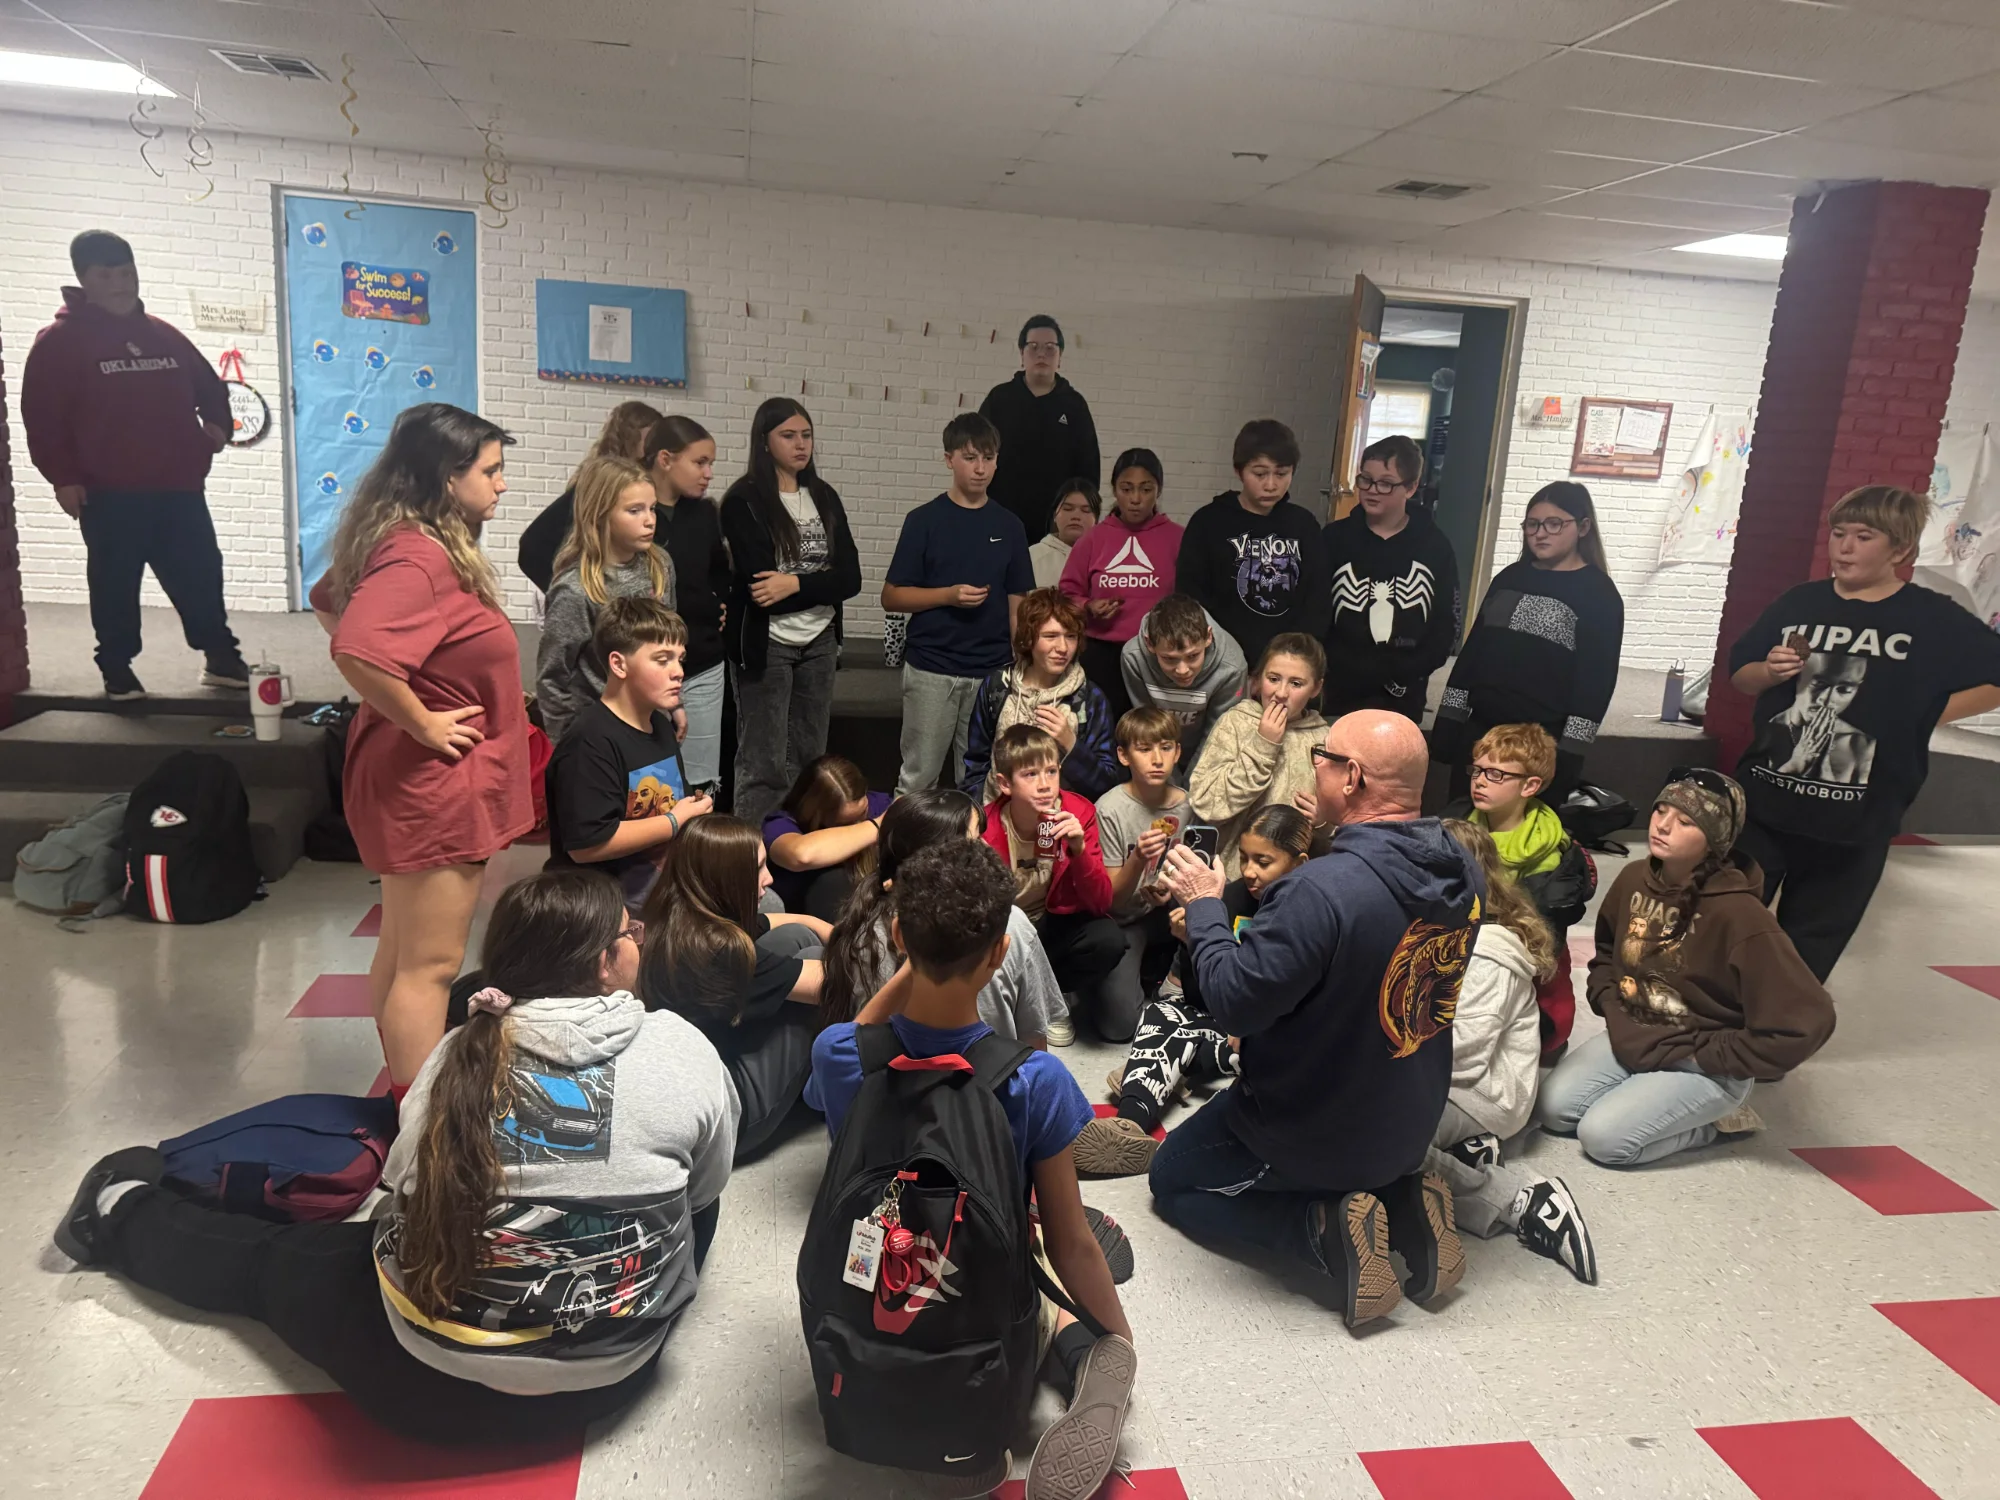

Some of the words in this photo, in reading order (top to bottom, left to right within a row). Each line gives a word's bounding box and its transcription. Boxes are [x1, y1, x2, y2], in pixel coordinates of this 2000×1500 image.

[360, 266, 388, 285] Swim
[366, 281, 412, 302] Success!
[1228, 533, 1302, 561] VENOM
[1099, 574, 1159, 589] Reebok
[1781, 624, 1913, 661] TUPAC
[1139, 1024, 1162, 1036] NIKE
